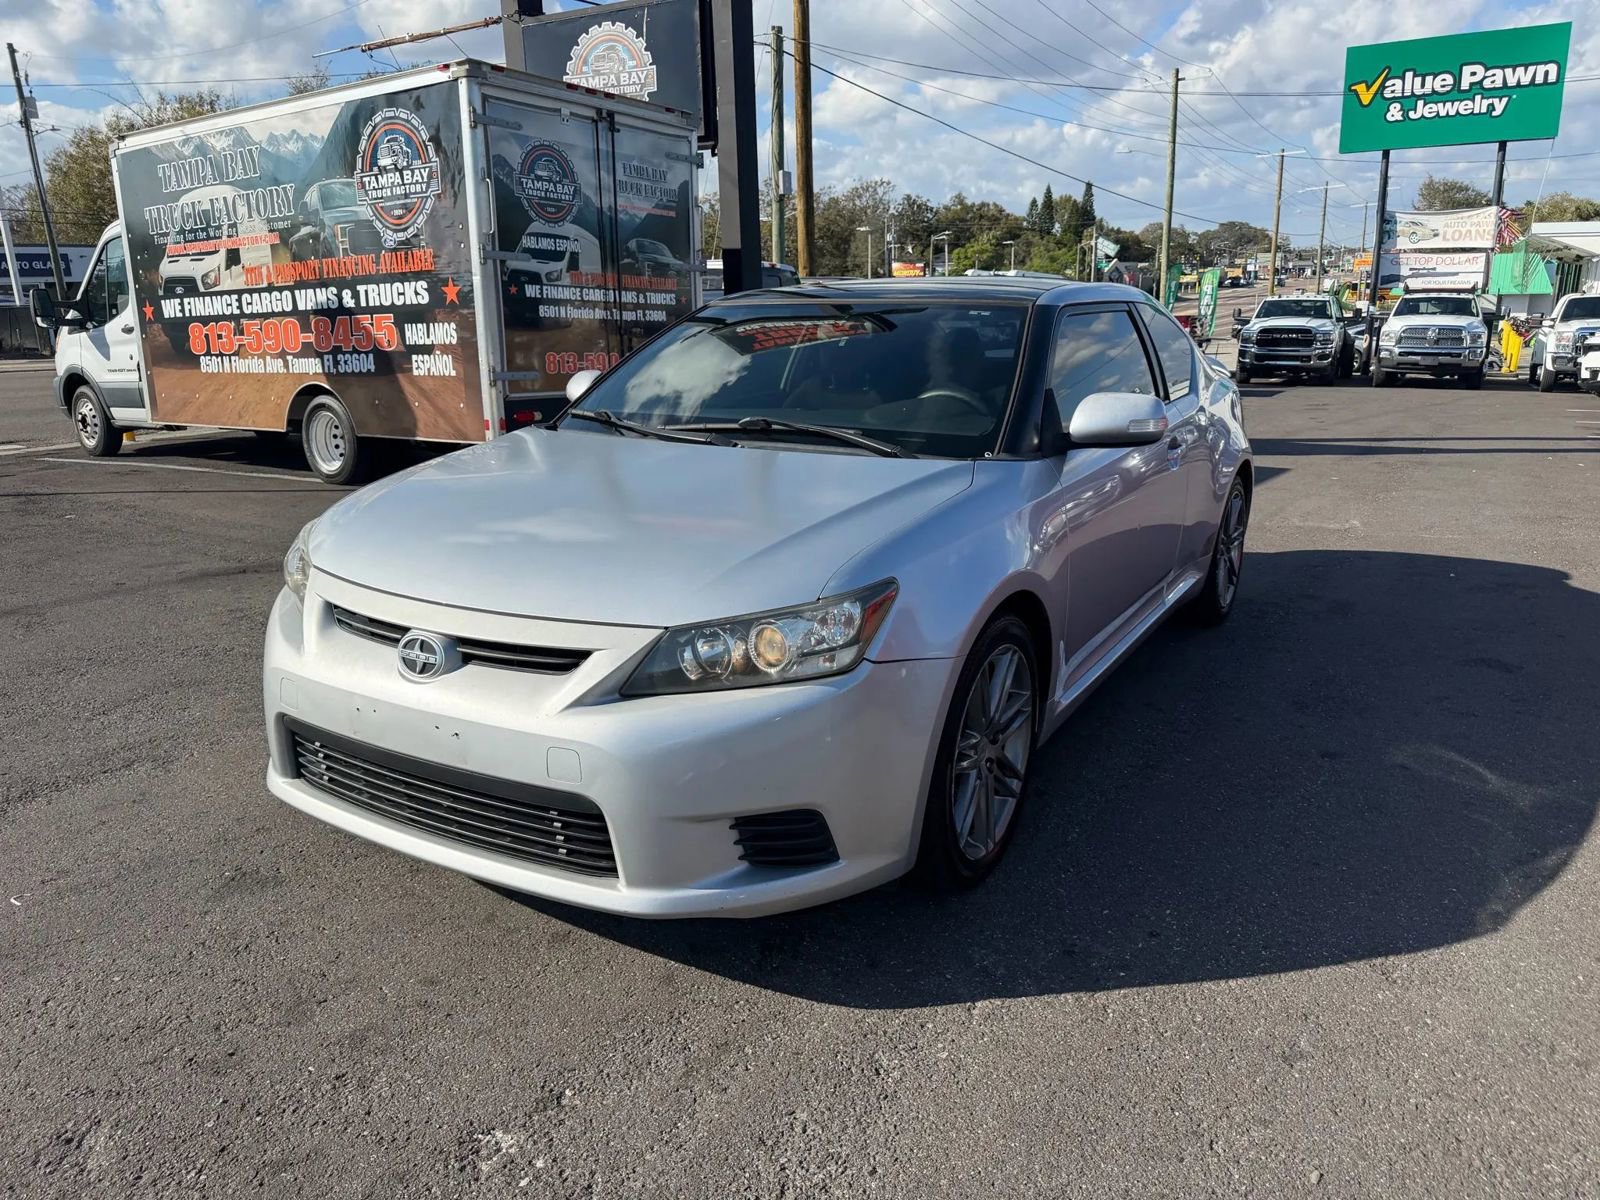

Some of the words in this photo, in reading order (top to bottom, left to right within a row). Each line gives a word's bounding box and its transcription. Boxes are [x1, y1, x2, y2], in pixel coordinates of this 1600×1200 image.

[620, 71, 647, 86] BAY
[1351, 67, 1454, 106] Value
[1460, 62, 1558, 90] Pawn
[1385, 103, 1404, 122] &
[1408, 95, 1508, 119] Jewelry
[158, 155, 219, 192] TAMPA
[221, 146, 260, 182] BAY
[362, 172, 401, 190] TAMPA
[402, 168, 430, 184] BAY
[368, 187, 391, 199] TRUCK
[392, 183, 427, 195] FACTORY
[521, 178, 555, 192] TAMPA
[557, 183, 575, 195] BAY
[525, 188, 545, 198] TRUCK
[547, 191, 573, 201] FACTORY
[144, 200, 206, 235] TRUCK
[209, 184, 295, 226] FACTORY
[185, 229, 194, 241] for
[196, 228, 206, 240] the
[1442, 229, 1494, 241] LOANS
[1443, 220, 1467, 229] AUTO
[522, 235, 556, 251] HABLAMOS
[556, 238, 581, 253] ESPAÑOL
[1, 261, 29, 270] ATO
[32, 261, 66, 270] GLAS
[322, 254, 376, 279] FINANCING
[379, 249, 435, 273] AVAILABLE
[1391, 256, 1412, 266] GET
[1413, 256, 1434, 266] TOP
[1435, 256, 1478, 266] DOLLAR
[161, 298, 183, 319] WE
[183, 294, 240, 317] FINANCE
[241, 290, 293, 314] CARGO
[295, 287, 339, 311] VANS
[342, 289, 355, 307] &
[357, 280, 430, 306] TRUCKS
[525, 284, 543, 298] WE
[543, 285, 581, 300] FINANCE
[582, 288, 614, 302] CARGO
[638, 293, 645, 304] &
[645, 293, 676, 305] TRUCKS
[538, 305, 560, 318] 8501
[560, 307, 566, 318] N
[567, 306, 593, 319] Florida
[645, 311, 667, 322] 33604
[188, 313, 397, 355] 813-590-8455
[404, 322, 458, 345] HABLAMOS
[200, 355, 223, 373] 8501
[223, 356, 231, 373] N
[231, 355, 264, 374] Florida
[287, 355, 322, 375] Tampa
[337, 352, 375, 373] 33604
[411, 350, 456, 376] ESPAÑOL
